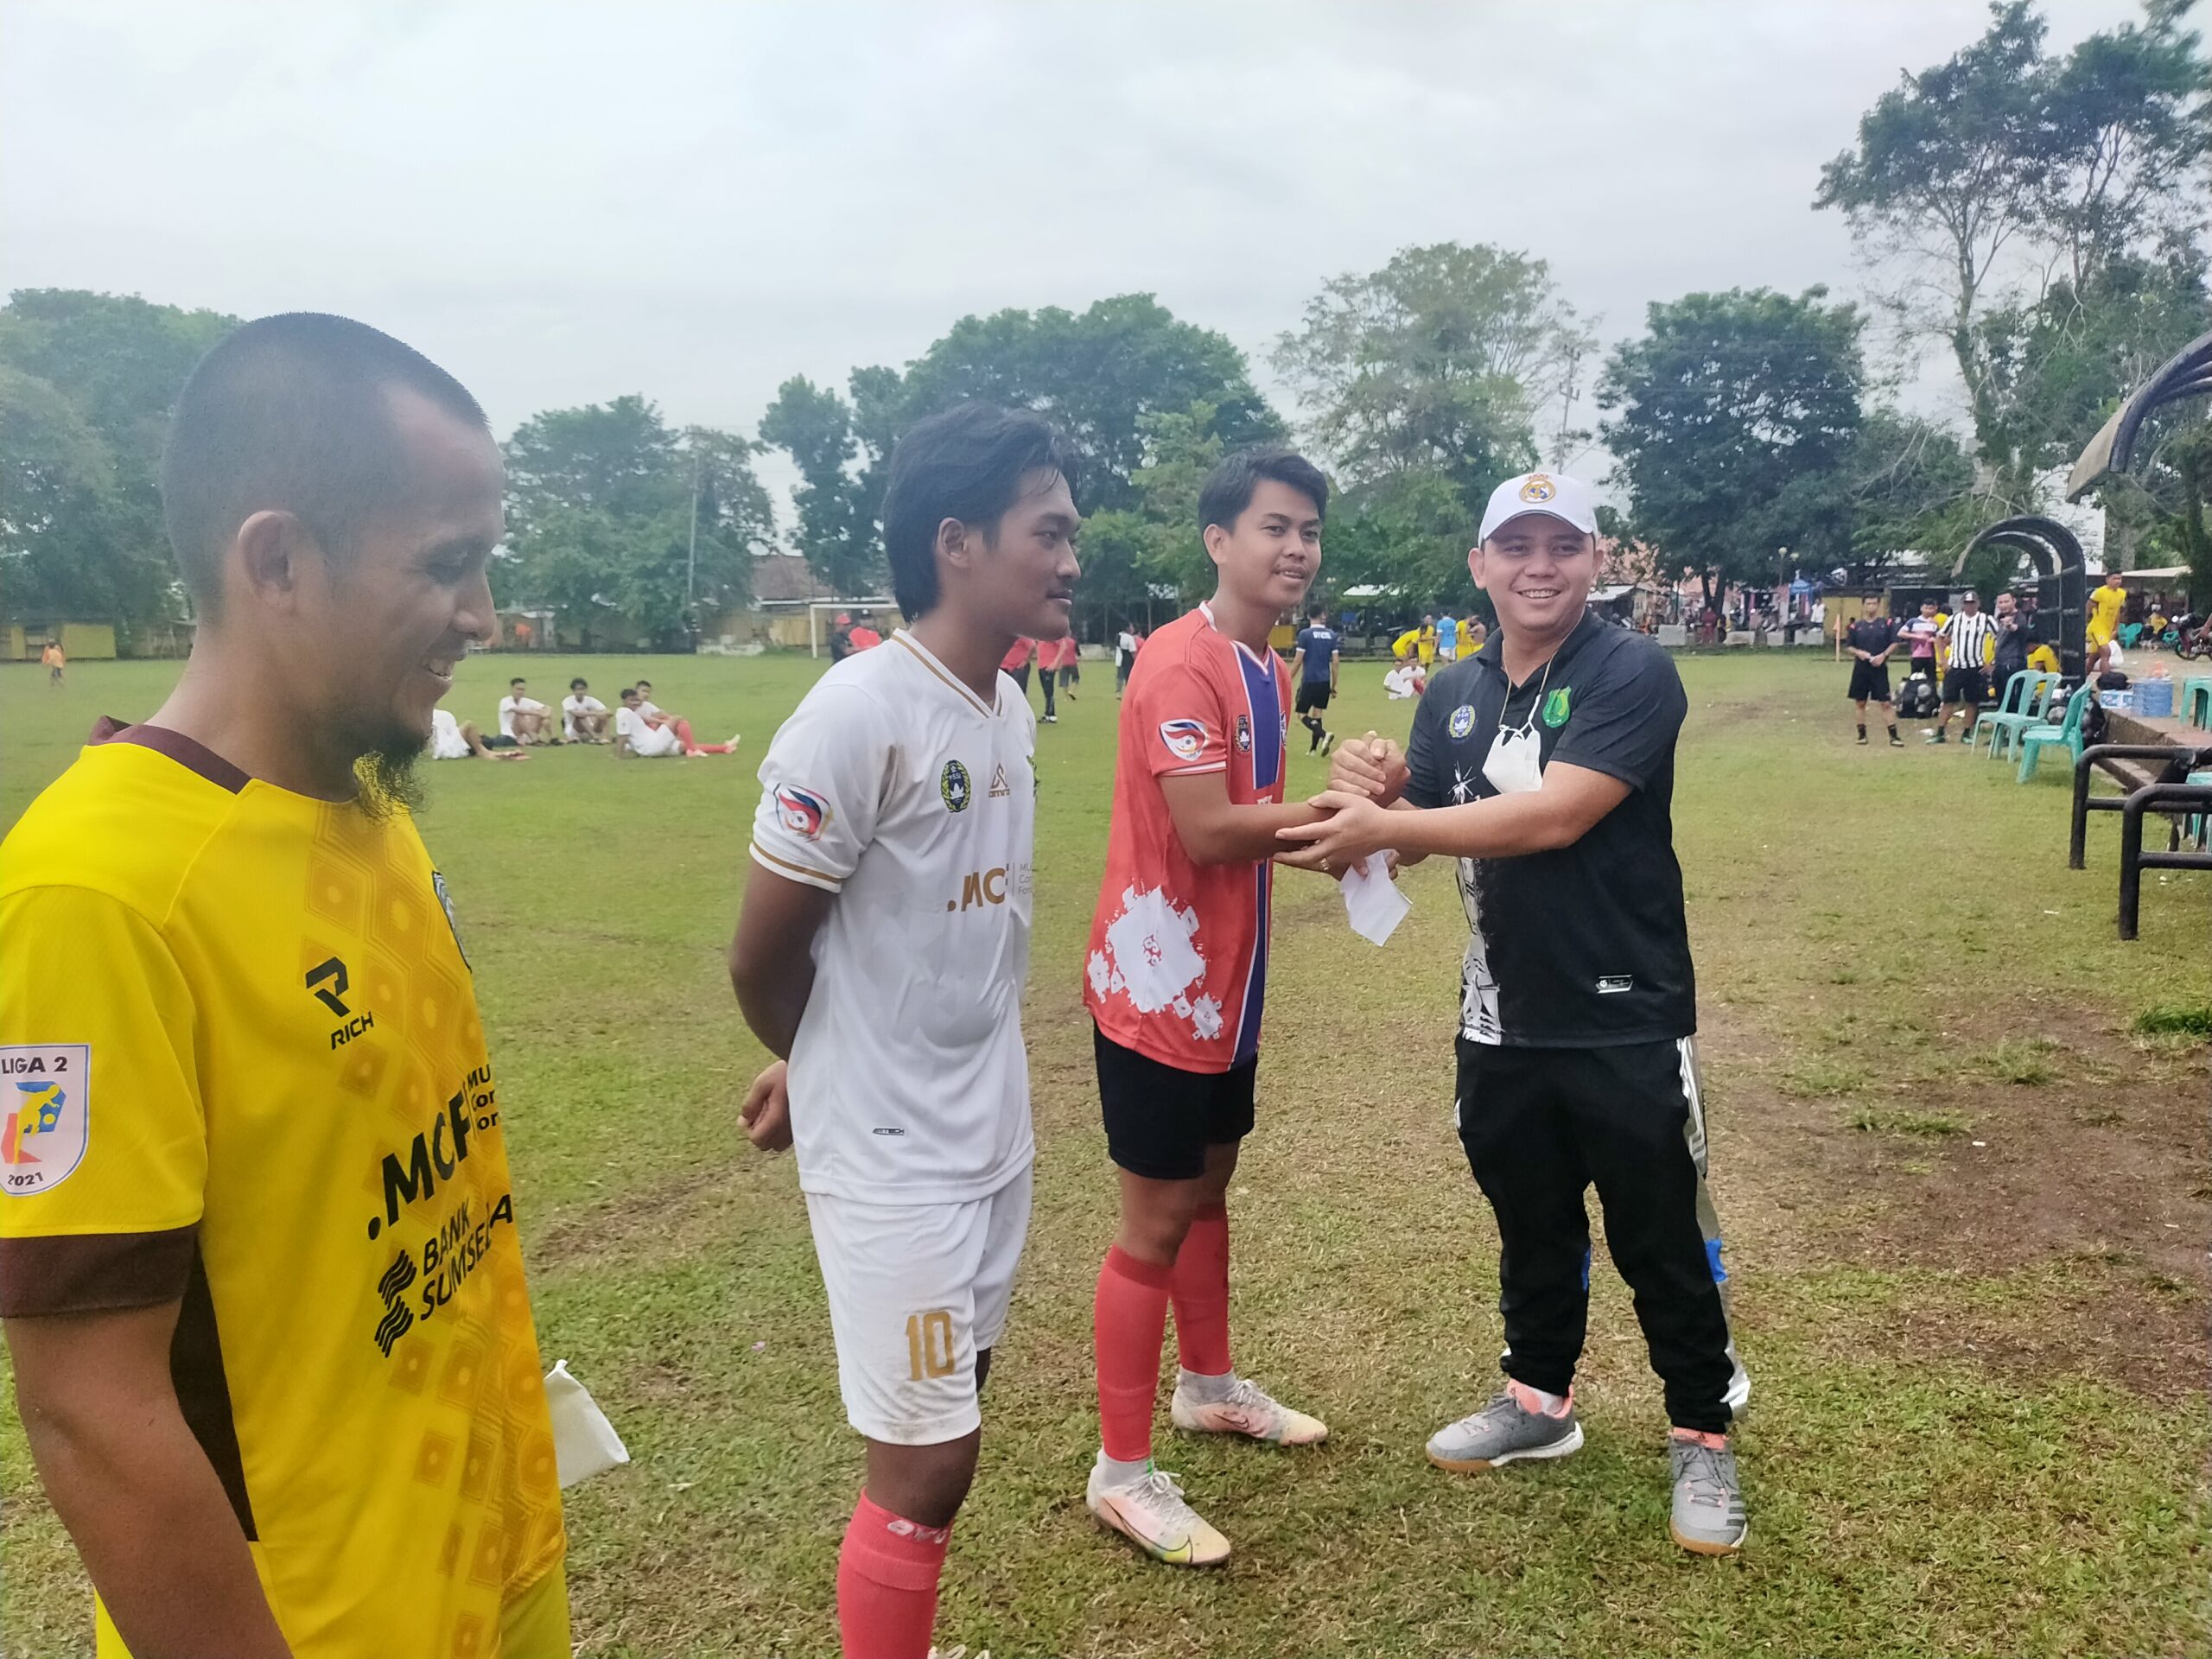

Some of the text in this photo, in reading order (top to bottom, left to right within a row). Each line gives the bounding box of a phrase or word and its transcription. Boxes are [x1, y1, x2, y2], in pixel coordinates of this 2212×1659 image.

[330, 1011, 374, 1051] RICH
[1, 1056, 67, 1075] LIGA 2
[8, 1171, 44, 1186] 2021
[423, 1196, 470, 1277] BANK
[905, 1310, 955, 1381] 10
